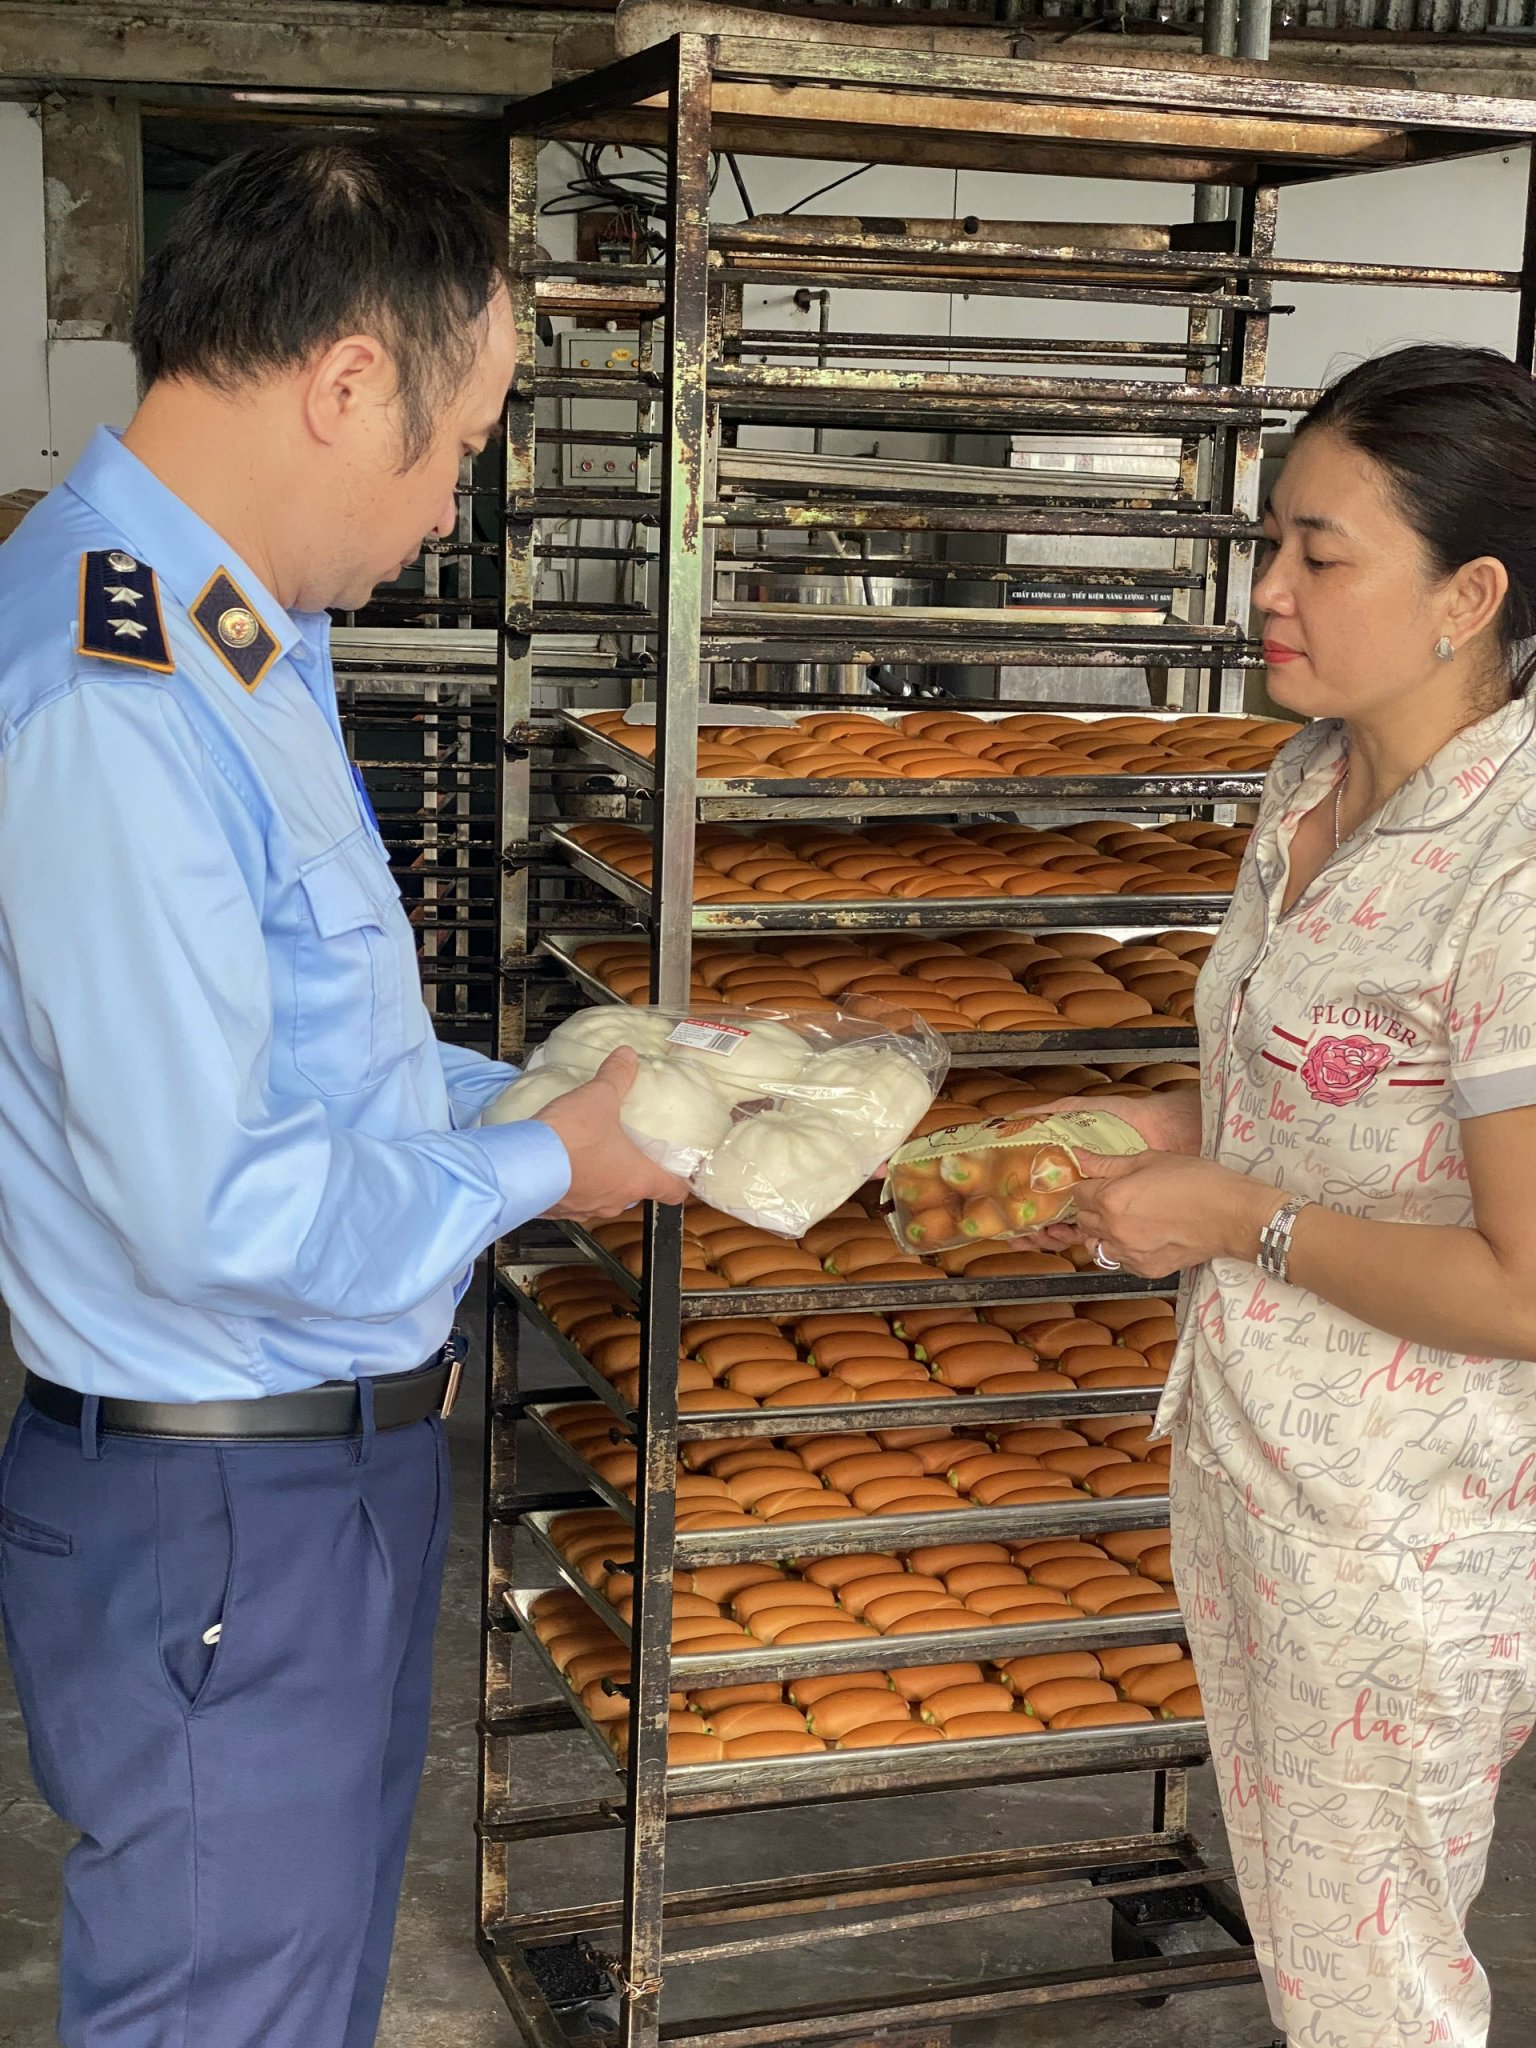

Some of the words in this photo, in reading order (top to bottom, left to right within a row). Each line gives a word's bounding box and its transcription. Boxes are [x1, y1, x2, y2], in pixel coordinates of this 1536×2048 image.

[1313, 1005, 1417, 1048] FLOWER
[1494, 1022, 1536, 1053] OVE
[1349, 1122, 1399, 1154] LOVE
[1240, 1325, 1278, 1351] LOVE
[1325, 1323, 1372, 1357] LOVE
[1463, 1370, 1497, 1393] LOVE
[1279, 1399, 1340, 1446] LOVE
[1367, 1448, 1429, 1501] love
[1270, 1533, 1317, 1585] LOVE
[1253, 1565, 1280, 1606] LOVE
[1346, 1592, 1411, 1643] love
[1290, 1672, 1332, 1711] LOVE
[1331, 1687, 1412, 1749] love
[1272, 1739, 1323, 1788] LOVE
[1307, 1872, 1355, 1905] LOVE
[1290, 1935, 1348, 1981] LOVE
